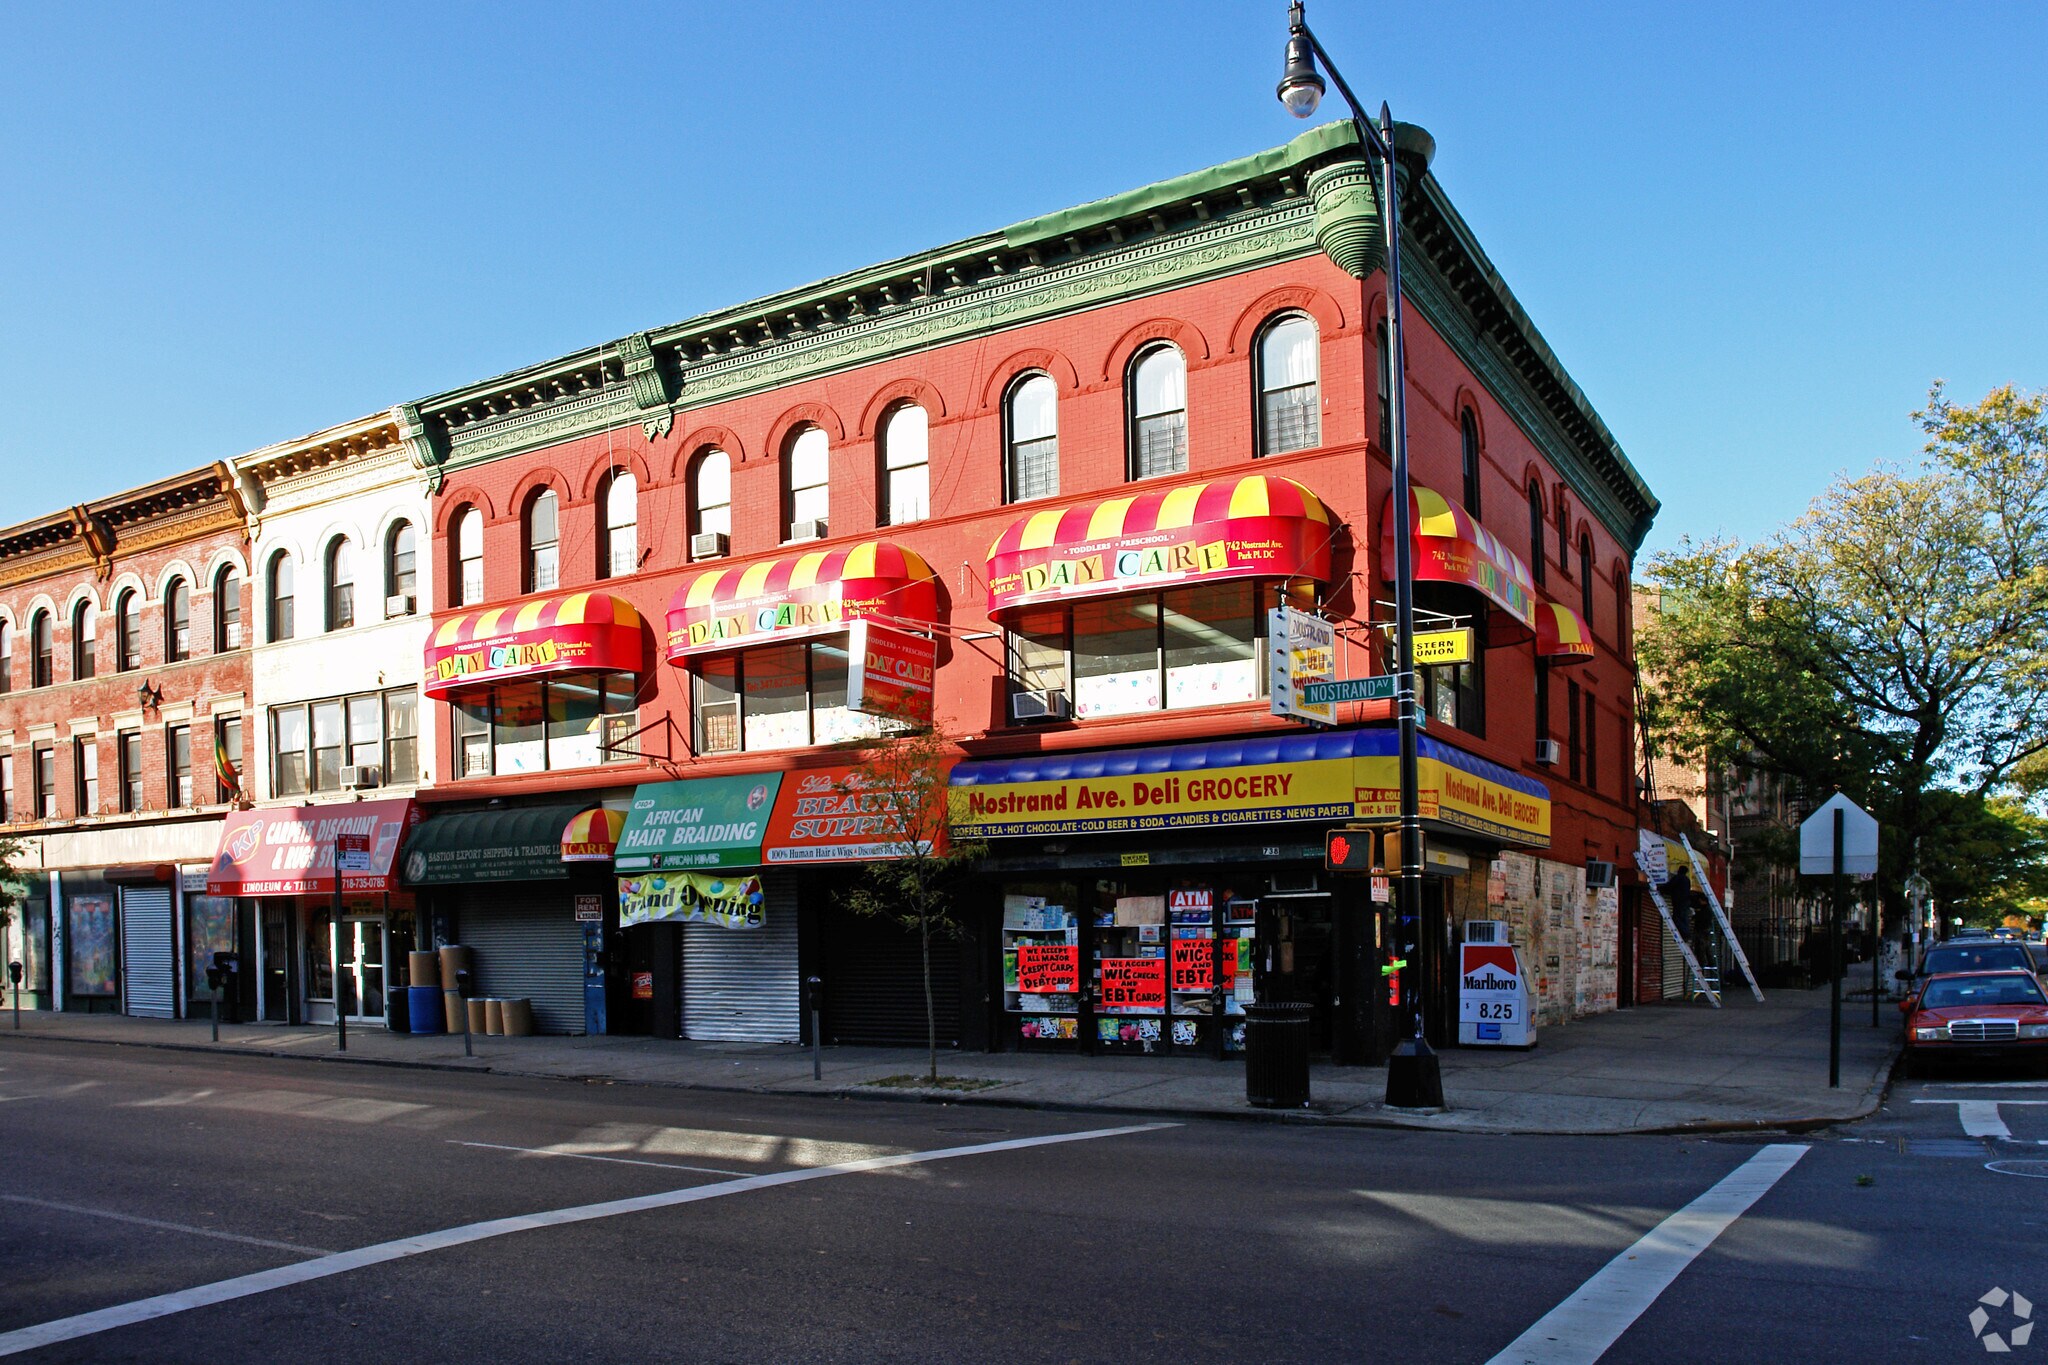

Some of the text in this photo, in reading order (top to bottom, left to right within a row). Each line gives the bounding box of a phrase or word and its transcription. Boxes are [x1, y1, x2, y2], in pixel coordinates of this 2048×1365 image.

[1069, 535, 1169, 555] TODDLERS PRESCHOOL
[1226, 540, 1284, 552] 742 Nostrand Ave.
[1237, 551, 1252, 560] Park
[1263, 549, 1275, 559] DC
[1432, 550, 1446, 560] 742
[1026, 557, 1097, 591] DAY
[1118, 545, 1223, 576] CARE
[715, 595, 789, 612] TODDLERS PRESCHOOL
[691, 616, 745, 643] DAY
[758, 604, 840, 630] CARE
[1293, 620, 1330, 645] NOSTRAND
[868, 636, 932, 659] TODDLERS PRESCHOOL
[1413, 640, 1454, 651] STERN
[1416, 648, 1454, 657] UNION
[439, 651, 483, 681] DAY
[491, 643, 555, 668] CARE
[866, 651, 932, 683] DAY CARE
[1310, 679, 1389, 702] NOSTRAND AV
[968, 773, 1293, 815] Nostrand Ave. Deli GROCERY
[1358, 791, 1373, 801] HOT
[1377, 791, 1382, 800] &
[1445, 772, 1480, 806] Nostrand
[1482, 786, 1498, 813] Ave.
[1499, 792, 1512, 817] Deli
[1514, 801, 1540, 825] GROCERY
[643, 808, 704, 826] AFRICAN
[1361, 805, 1396, 815] WIC & EBT
[953, 805, 1350, 837] COFFEE TEA HOT CHOCOLATE COLD BEER & SODA CANDIES & CIGARETTES NEWS PAPER
[265, 815, 379, 846] CARPETS DISCOUNT
[625, 822, 757, 847] HAIR BRAIDING
[219, 819, 264, 874] AKP
[428, 850, 455, 863] BASTION
[456, 848, 482, 860] EXPORT
[483, 847, 513, 858] SHIPPING
[514, 847, 519, 856] &
[521, 844, 550, 857] TRADING
[551, 844, 562, 855] LL
[568, 843, 608, 855] CARE
[771, 849, 788, 860] 100%
[789, 847, 814, 859] Human
[815, 847, 831, 858] Hair
[837, 846, 854, 859] Wigs
[271, 847, 284, 870] &
[283, 845, 316, 870] RUGS
[663, 854, 693, 866] AFRICAN
[210, 877, 385, 894] 744 LINOLEUM & TILES 718-735-0785
[1372, 877, 1388, 889] ATM
[680, 884, 763, 925] Opning
[1174, 891, 1209, 906] ATM
[1198, 941, 1230, 949] ACCT
[1027, 955, 1040, 963] ALL
[1175, 949, 1204, 962] WIC
[1021, 963, 1074, 976] CREDIT CARDS
[1104, 969, 1160, 981] WIC CHECKS
[1175, 969, 1207, 985] EBT
[1024, 978, 1050, 989] DEBT
[1463, 973, 1517, 991] Marlboro
[1104, 988, 1162, 1003] EBT CARDS
[1465, 1002, 1513, 1020] $ 8.25
